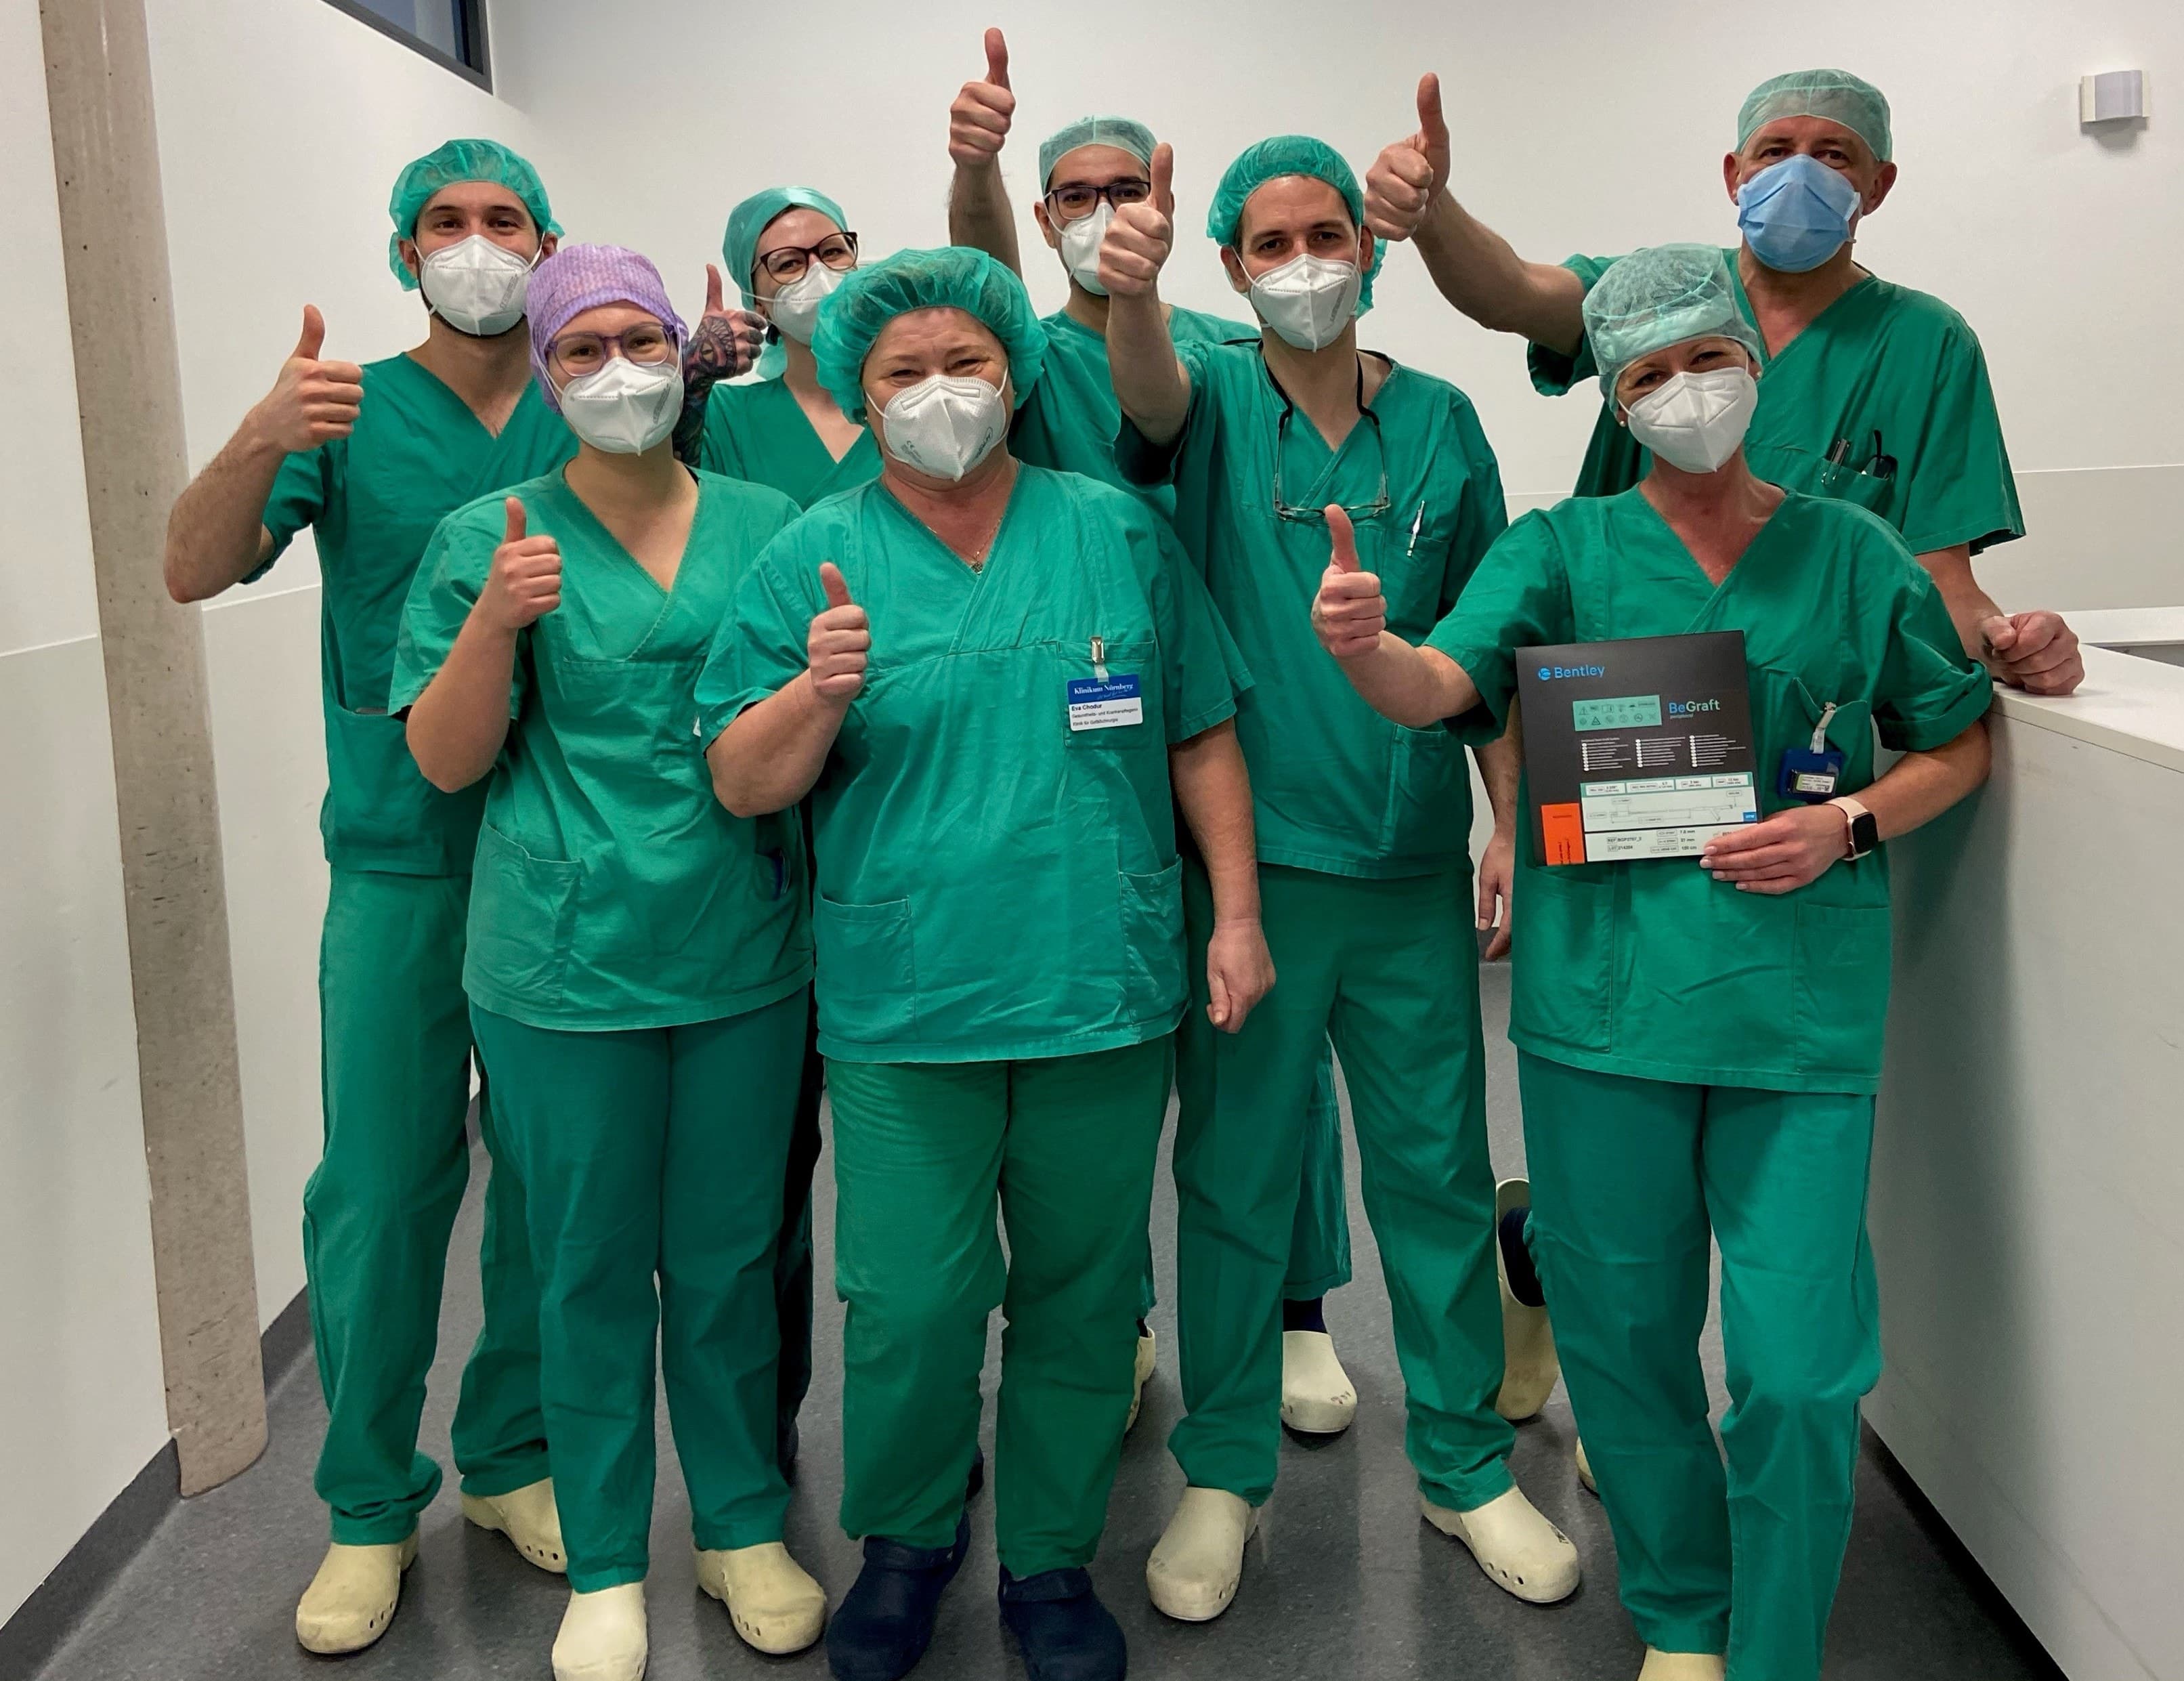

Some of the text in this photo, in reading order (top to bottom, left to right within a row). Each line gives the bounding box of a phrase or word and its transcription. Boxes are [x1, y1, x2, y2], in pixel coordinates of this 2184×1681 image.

[1554, 664, 1605, 679] Bentley
[1074, 687, 1103, 695] Klinikum
[1669, 699, 1721, 714] BeGraft
